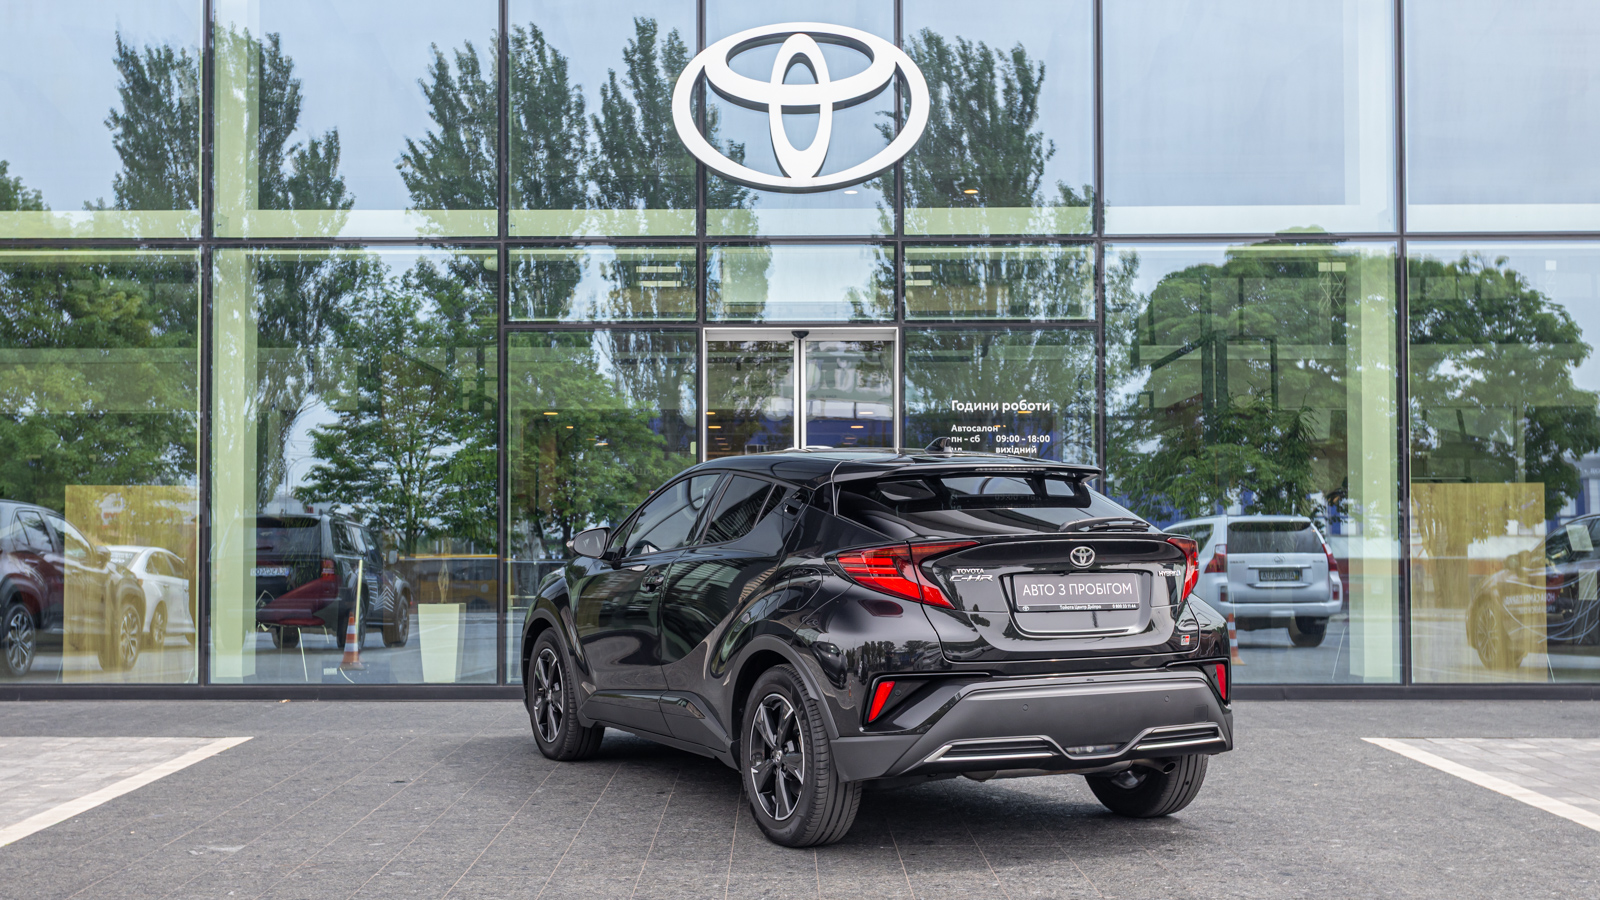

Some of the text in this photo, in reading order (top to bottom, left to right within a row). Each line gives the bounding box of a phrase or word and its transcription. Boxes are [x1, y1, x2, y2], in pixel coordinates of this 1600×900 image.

[951, 399, 1051, 413] Години роботи
[951, 424, 999, 432] Автосалон
[970, 434, 981, 443] сб
[995, 435, 1020, 443] 09:00
[1027, 435, 1051, 443] 18:00
[996, 445, 1037, 454] вихідний
[1022, 584, 1055, 596] АВТО
[1069, 582, 1133, 595] ПРОБІГОМ
